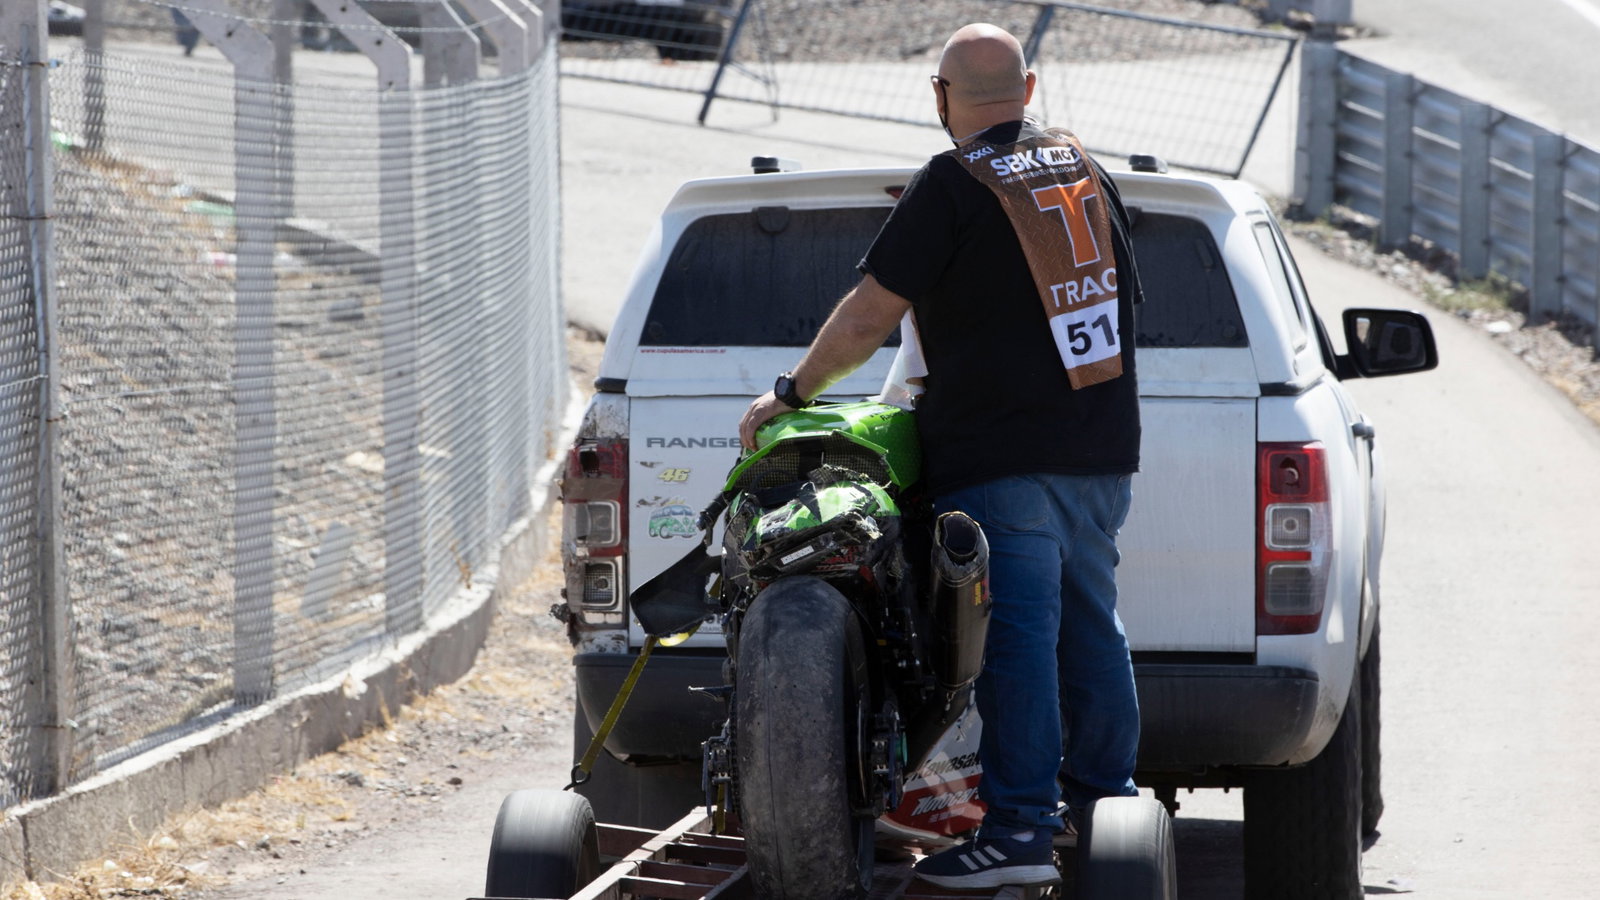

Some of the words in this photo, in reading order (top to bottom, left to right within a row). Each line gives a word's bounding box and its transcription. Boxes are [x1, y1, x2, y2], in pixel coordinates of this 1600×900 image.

[990, 150, 1042, 176] SBK
[1031, 176, 1100, 268] T
[1067, 313, 1120, 356] 51
[658, 468, 691, 483] 46
